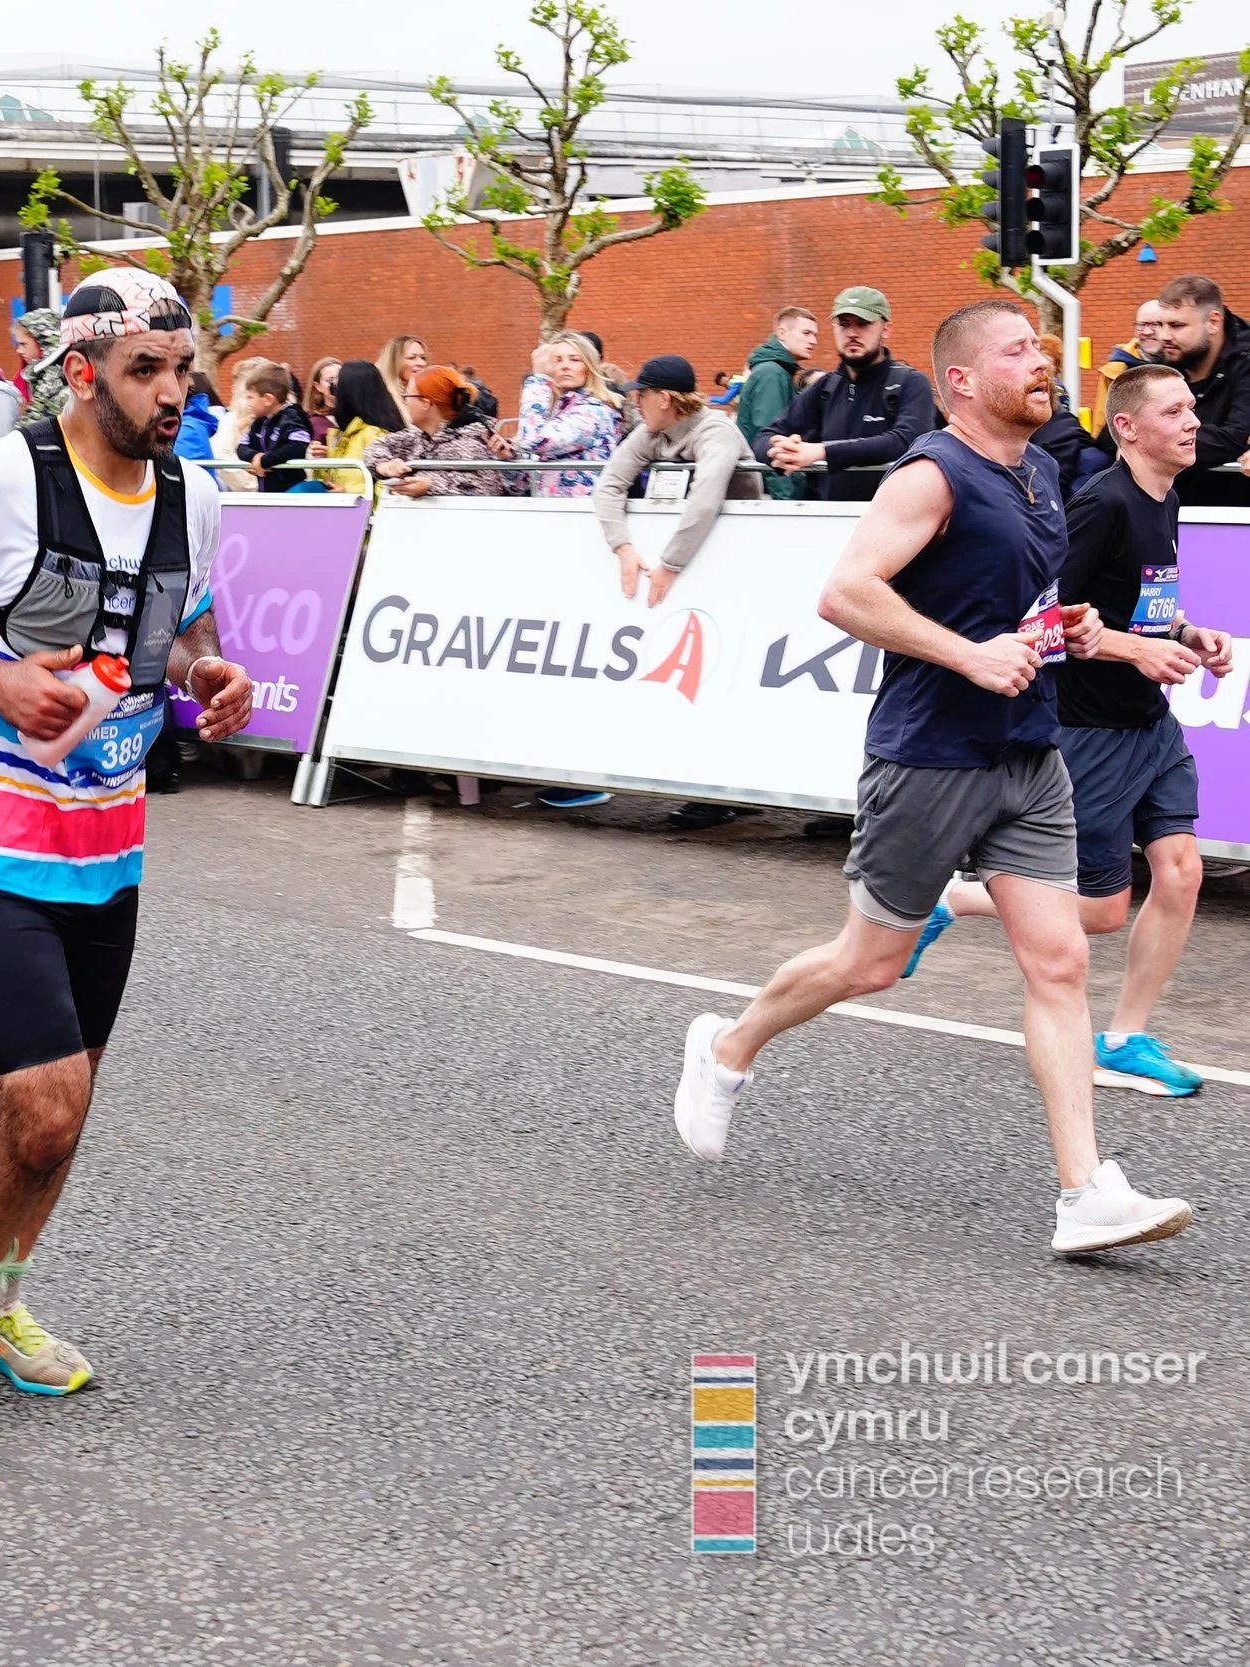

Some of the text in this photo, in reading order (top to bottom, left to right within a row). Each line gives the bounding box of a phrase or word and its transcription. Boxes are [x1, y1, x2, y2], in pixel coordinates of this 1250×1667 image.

[1141, 587, 1162, 597] HARRY
[1147, 597, 1176, 619] 6766
[362, 594, 646, 682] GRAVELLS
[101, 732, 143, 770] 389
